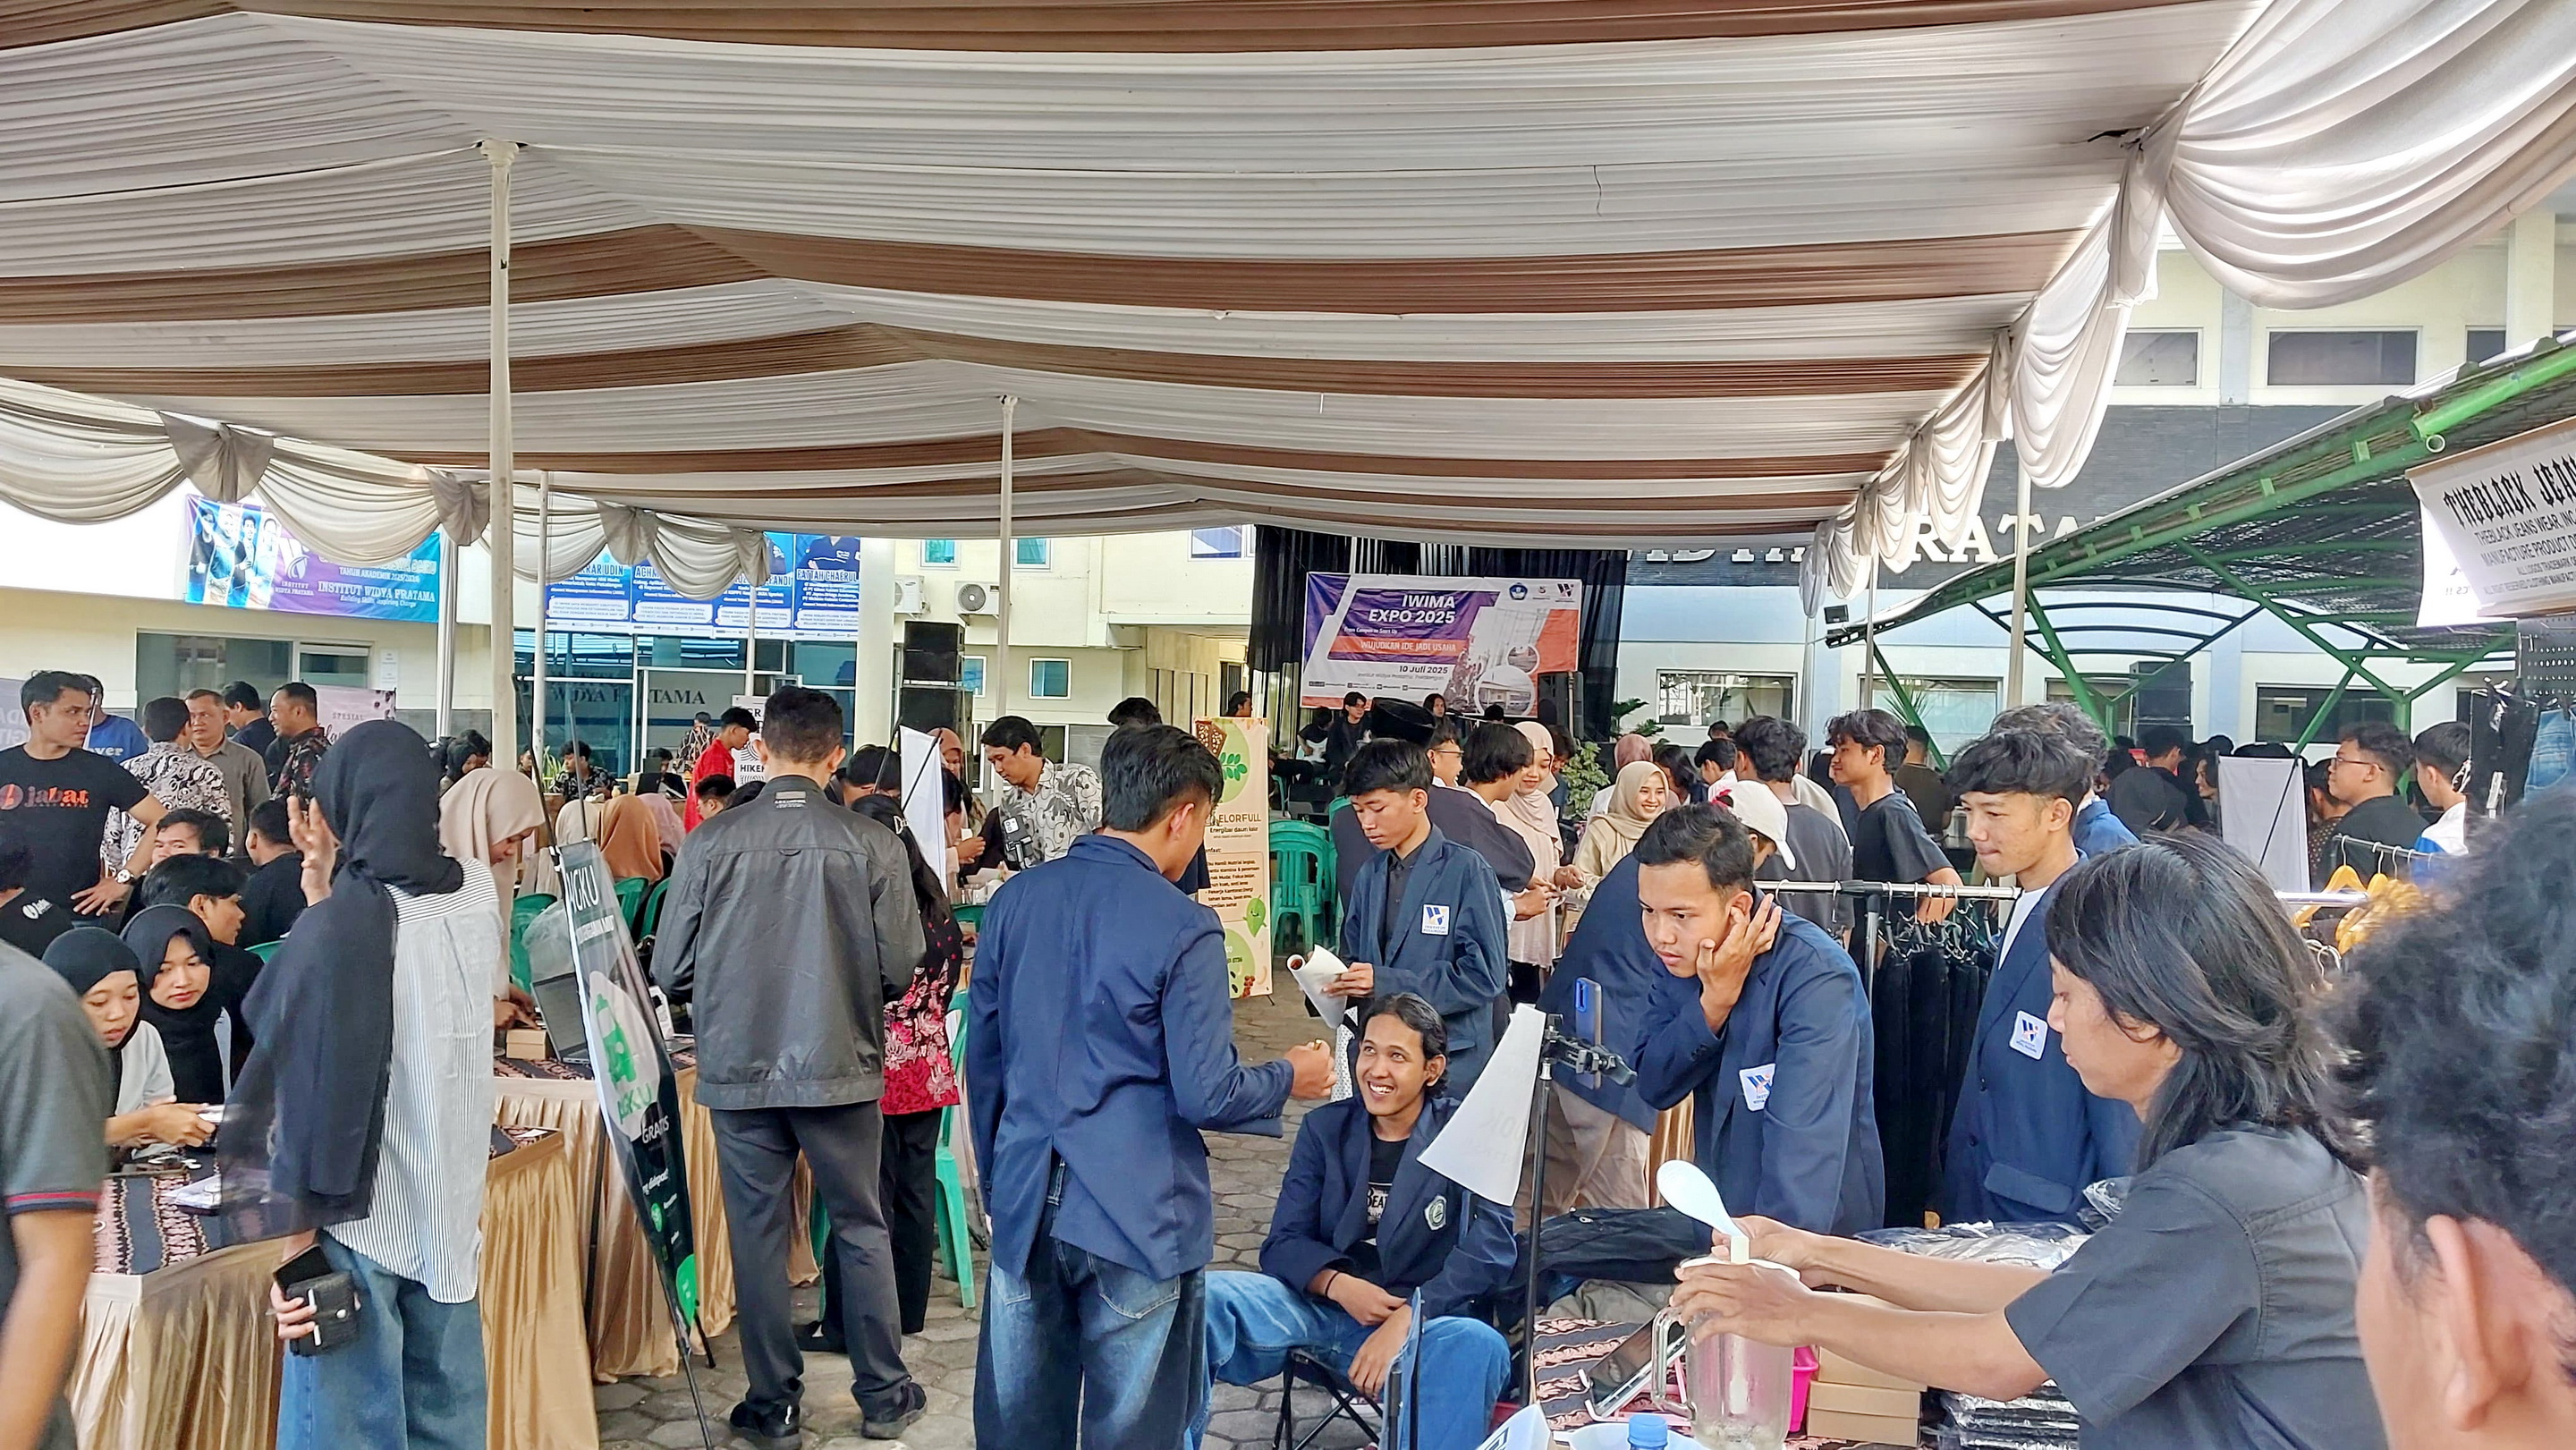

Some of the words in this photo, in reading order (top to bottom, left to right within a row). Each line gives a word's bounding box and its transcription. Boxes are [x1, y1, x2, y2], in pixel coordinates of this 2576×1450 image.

[2443, 471, 2538, 530] THEBLACK
[2474, 525, 2515, 546] THEBLACK
[2512, 520, 2538, 538] JEANS
[2480, 544, 2536, 566] MANUFACTURE
[2531, 536, 2571, 556] PRODUCT
[797, 569, 824, 581] FATTAH
[318, 581, 362, 596] INSTITUT
[364, 586, 393, 600] WIDYA
[394, 589, 436, 603] PRATAMA
[1402, 595, 1455, 608] IWIMA
[1368, 609, 1412, 623] EXPO
[1415, 610, 1456, 623] 2025
[1360, 640, 1400, 649] WUJUDKAN
[1401, 642, 1413, 650] IDE
[1415, 643, 1431, 651] JADI
[1432, 644, 1456, 652] USAHA
[553, 688, 605, 703] WDYA
[1218, 813, 1261, 823] ELORFULL
